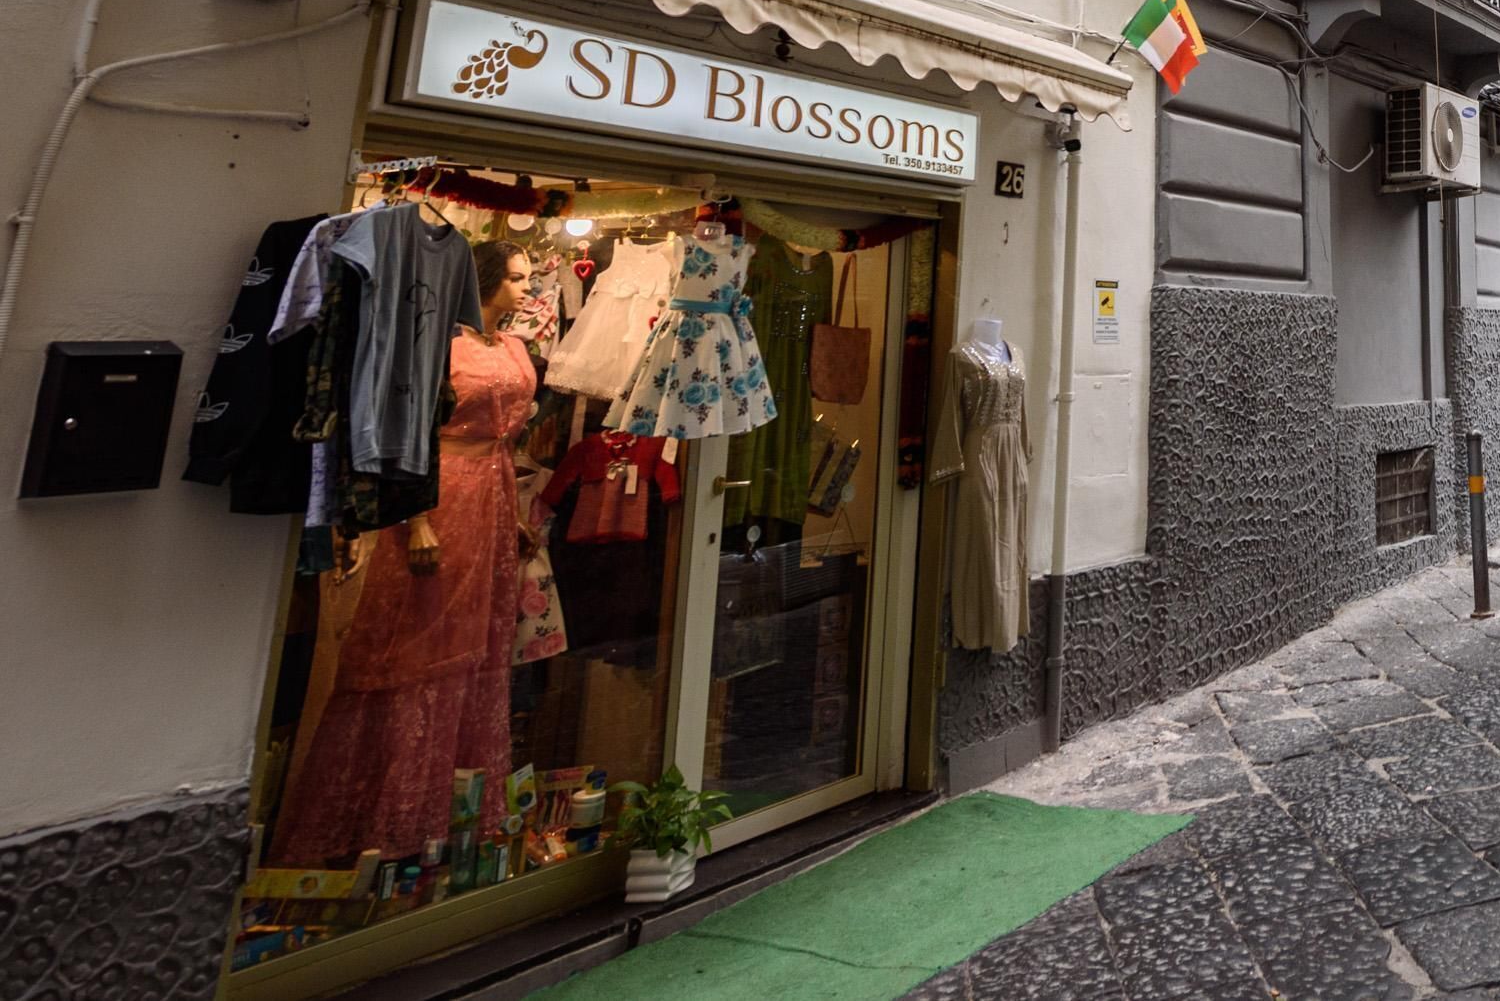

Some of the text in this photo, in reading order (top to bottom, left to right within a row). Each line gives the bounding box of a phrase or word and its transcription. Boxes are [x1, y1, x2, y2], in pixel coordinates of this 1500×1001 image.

[566, 38, 965, 163] SD Blossoms
[882, 153, 964, 176] Tel. 350.9133457
[1001, 165, 1024, 194] 26
